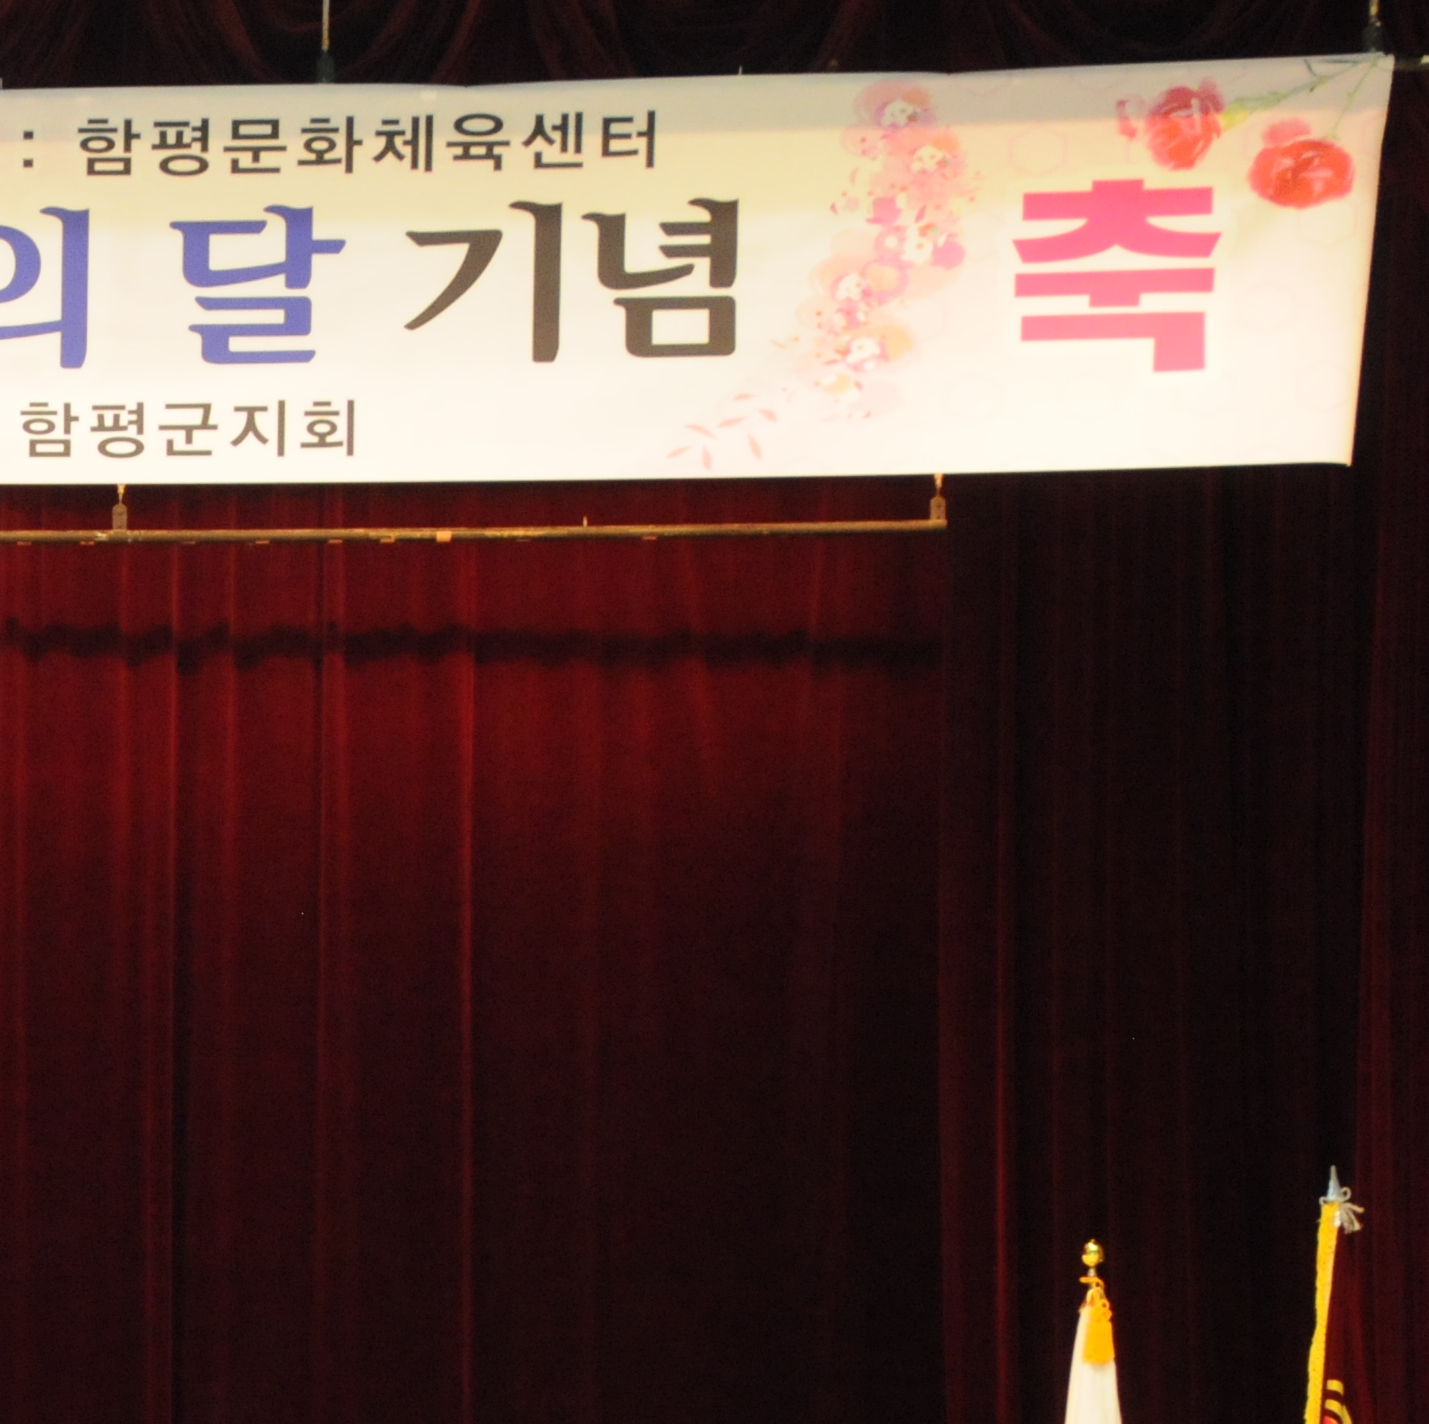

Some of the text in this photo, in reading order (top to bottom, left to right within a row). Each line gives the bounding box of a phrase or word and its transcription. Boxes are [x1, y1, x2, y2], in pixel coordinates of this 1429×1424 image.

[78, 110, 655, 176] 함평문화체육센터
[170, 205, 346, 364] 달
[405, 198, 739, 362] 기념
[1014, 179, 1221, 371] 축
[21, 400, 354, 458] 함평군지회
